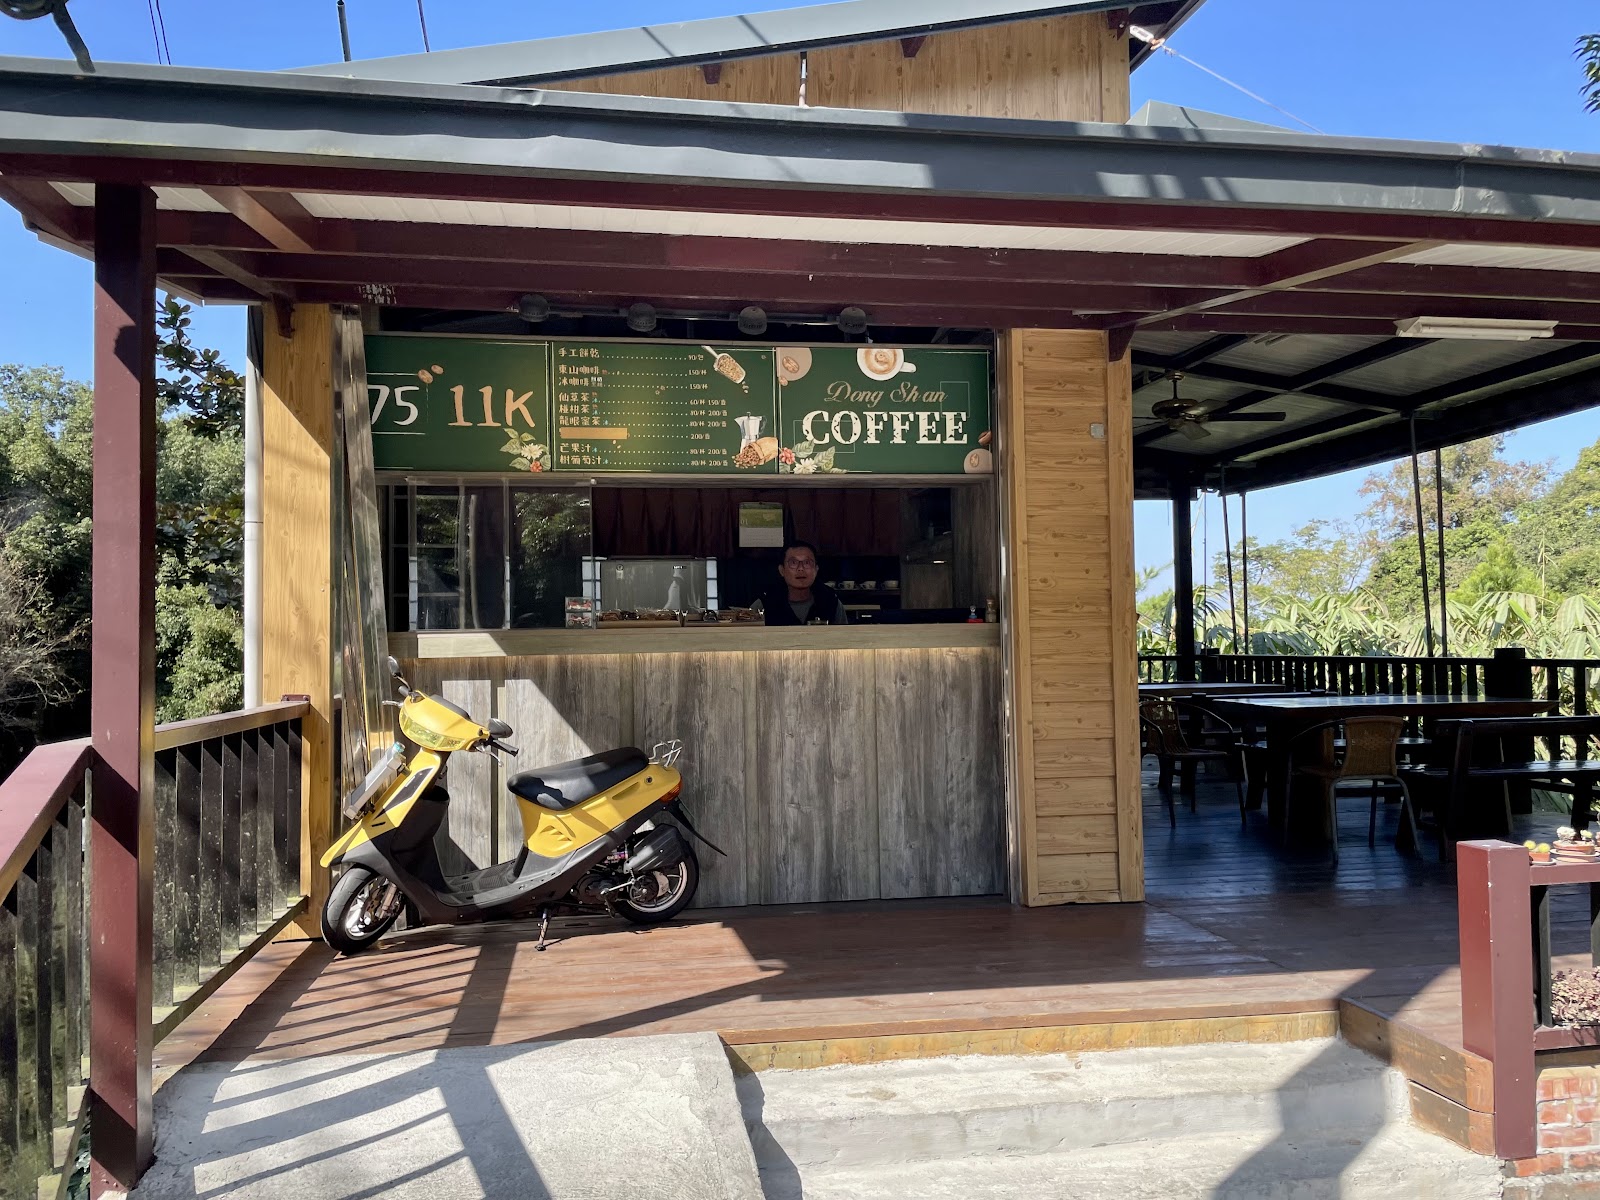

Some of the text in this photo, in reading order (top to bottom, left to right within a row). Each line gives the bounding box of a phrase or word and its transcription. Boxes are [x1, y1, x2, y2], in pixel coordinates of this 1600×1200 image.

[558, 347, 600, 358] 手工餅乾
[558, 364, 600, 375] 東山咖啡
[558, 376, 589, 387] 冰咖啡
[558, 392, 590, 402] 仙草茶
[824, 381, 884, 408] Dong
[447, 384, 536, 428] 11K
[559, 415, 600, 426] 龍眼蜜茶
[802, 410, 968, 444] COFFEE
[560, 443, 591, 453] 芒果汁
[560, 454, 601, 465] 樹葡萄汁
